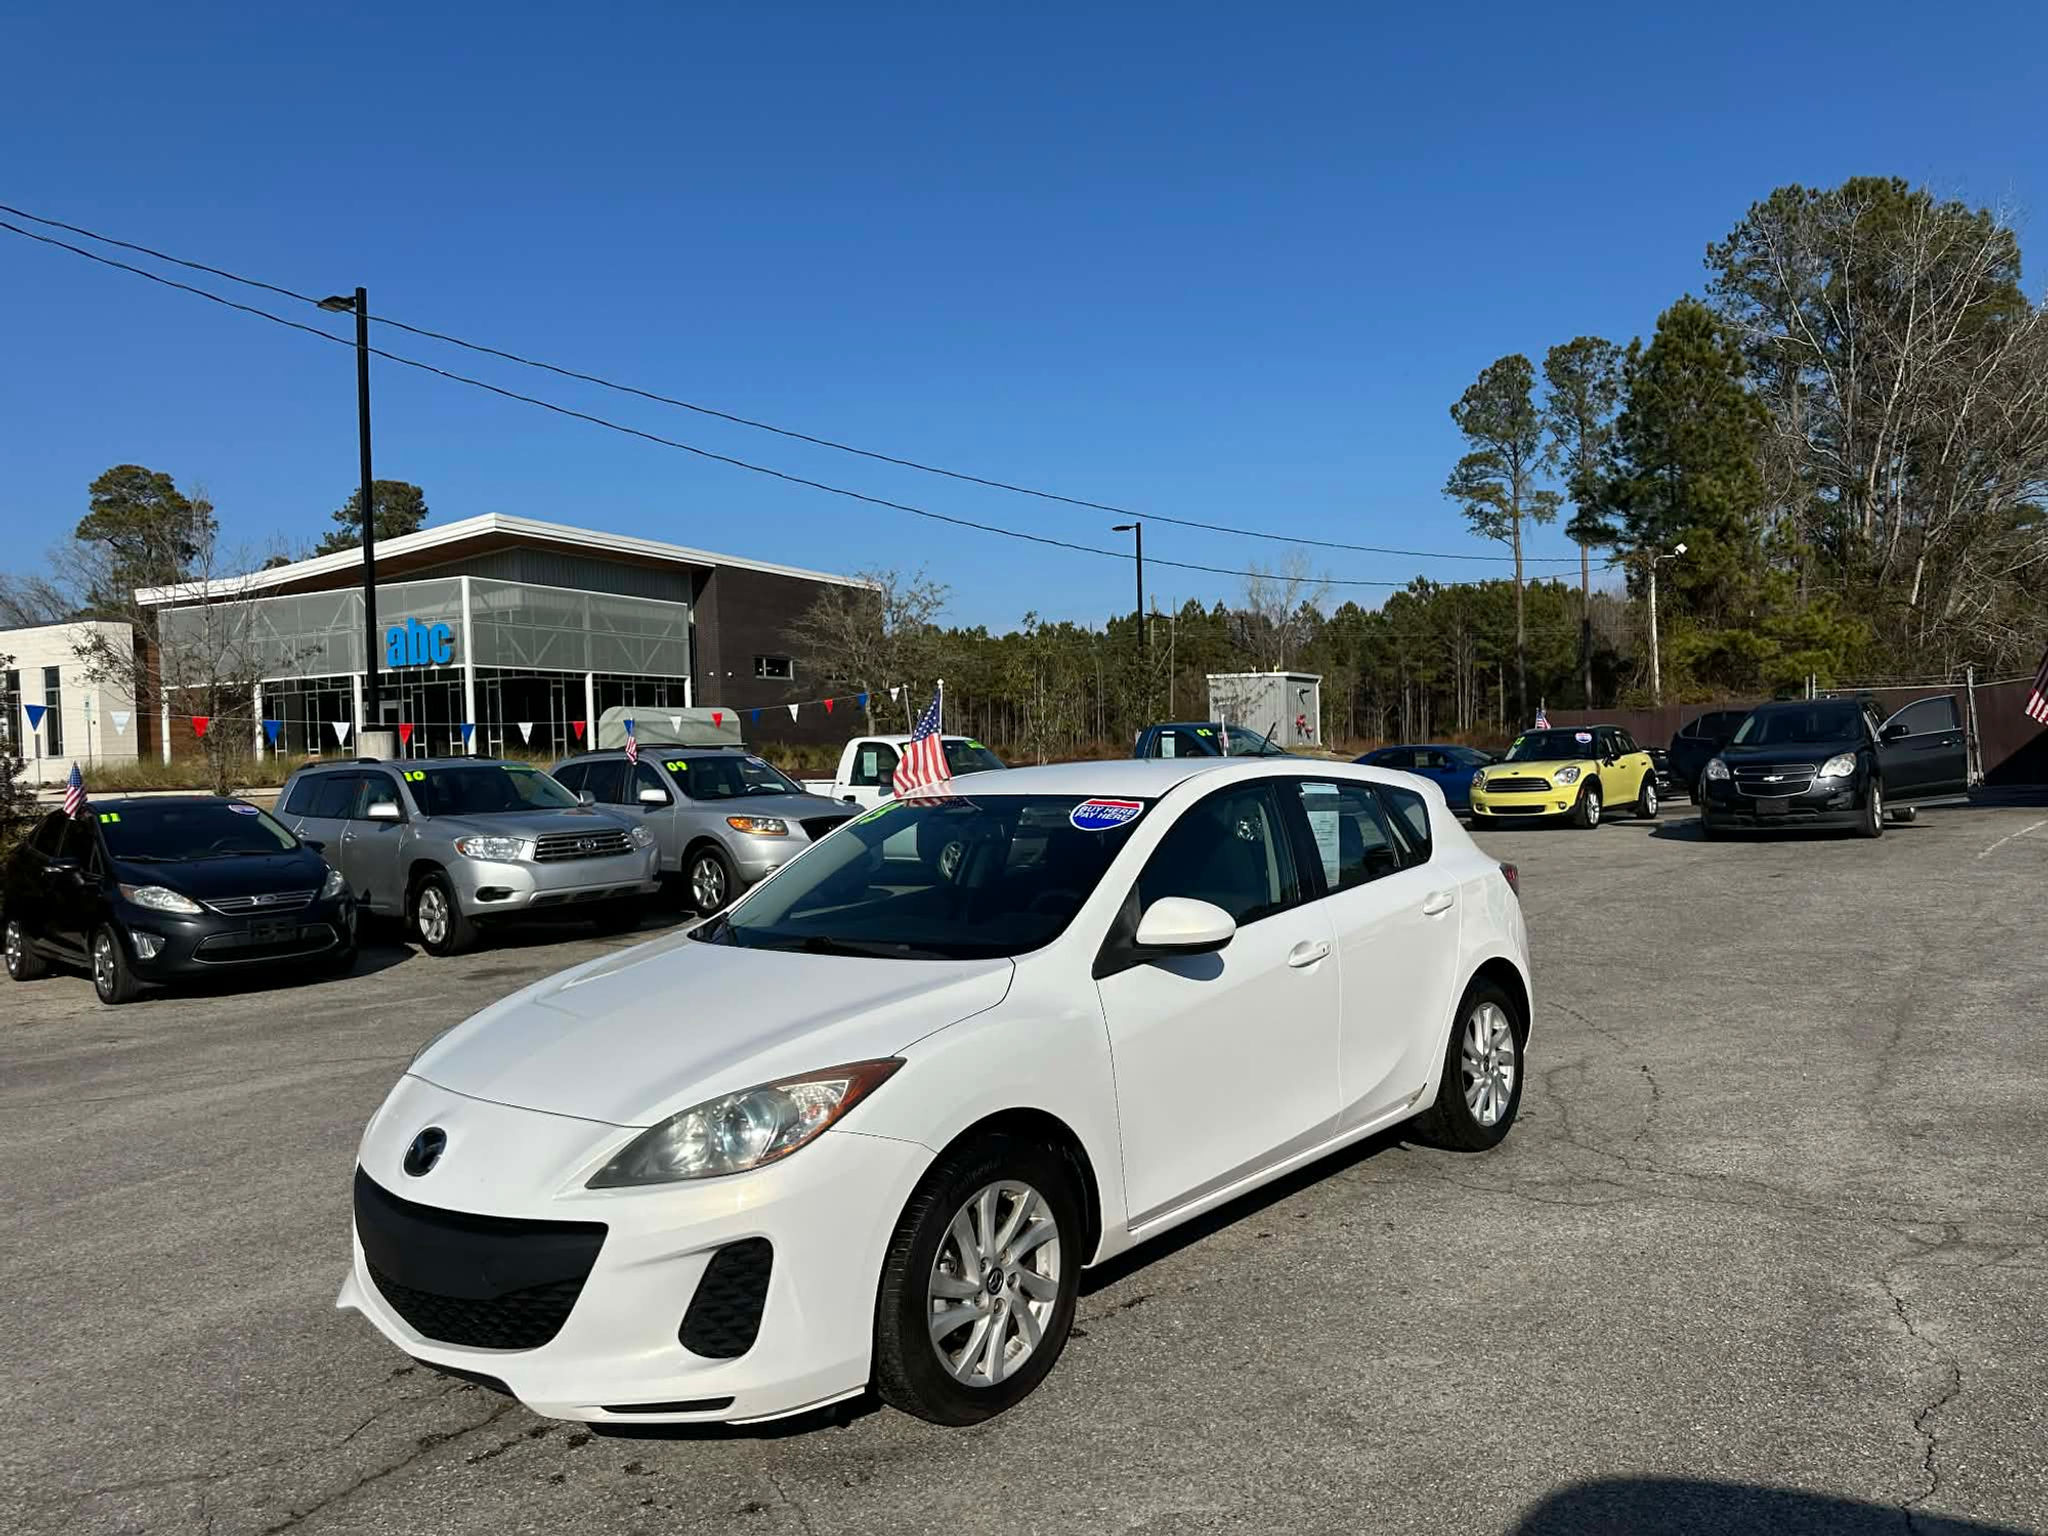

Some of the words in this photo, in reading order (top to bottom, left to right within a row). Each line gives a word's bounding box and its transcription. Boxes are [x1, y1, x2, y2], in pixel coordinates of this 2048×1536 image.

[387, 617, 451, 668] abc
[666, 761, 688, 772] 09
[403, 770, 425, 782] 10
[1074, 811, 1097, 819] PAY
[1097, 813, 1130, 821] HERE
[1079, 805, 1103, 814] BUY
[1104, 807, 1136, 816] HERE
[100, 813, 121, 823] 11
